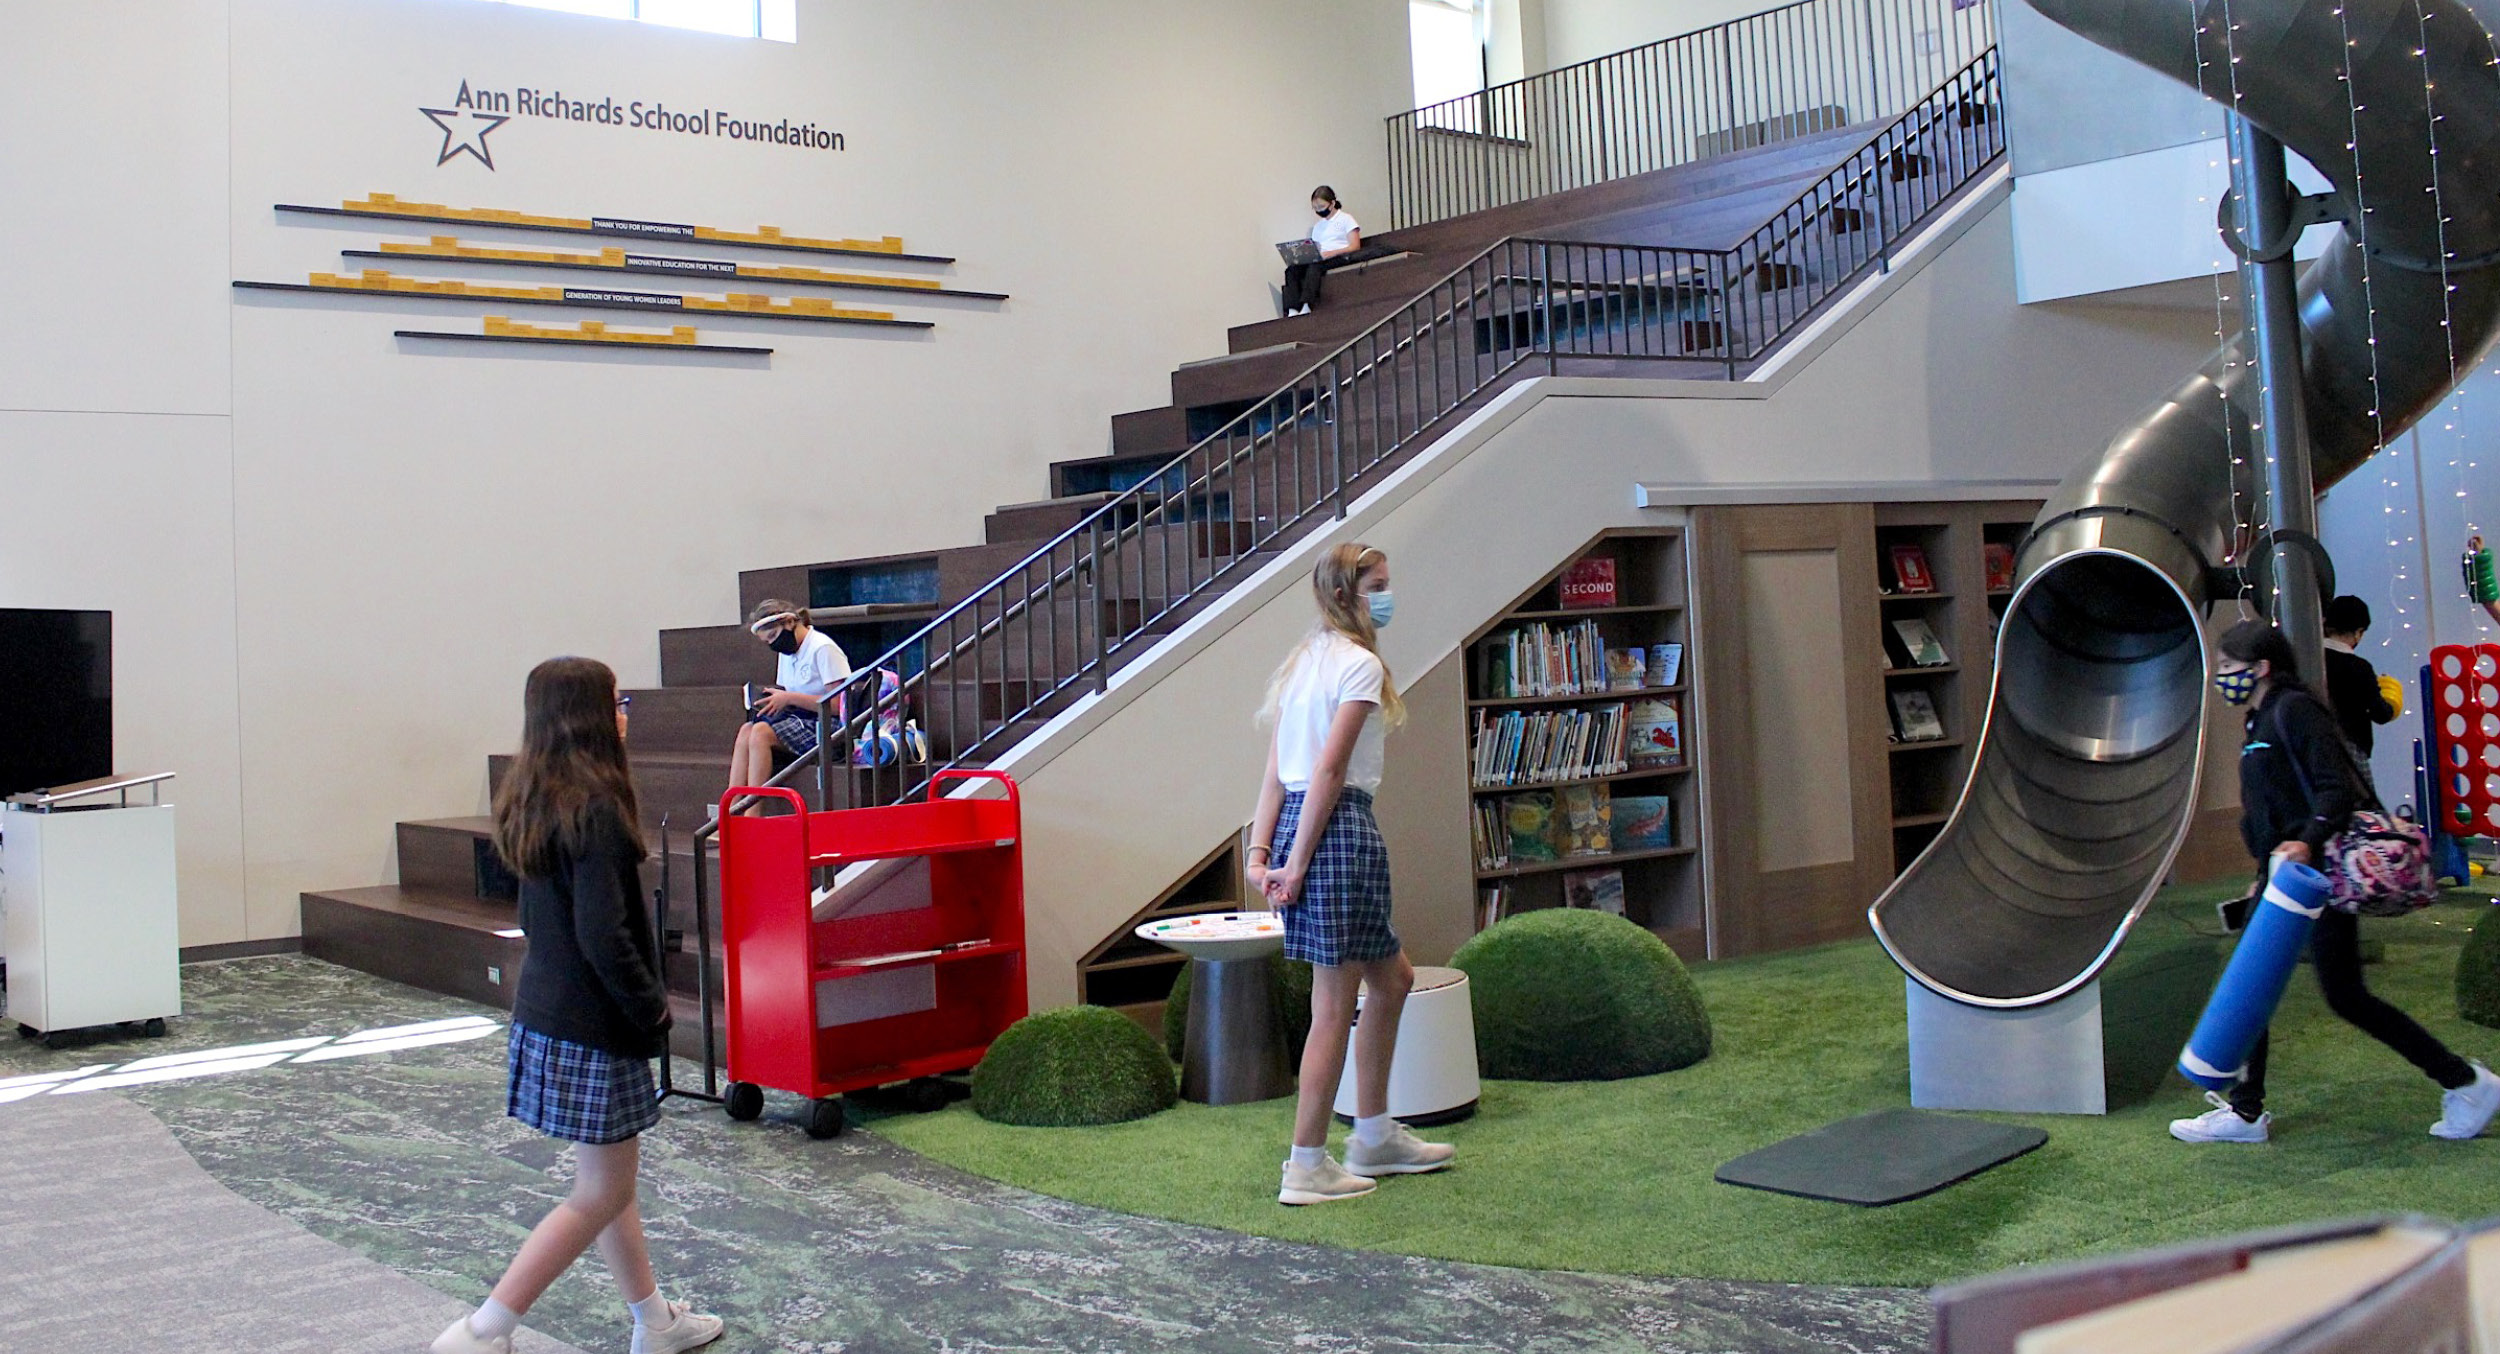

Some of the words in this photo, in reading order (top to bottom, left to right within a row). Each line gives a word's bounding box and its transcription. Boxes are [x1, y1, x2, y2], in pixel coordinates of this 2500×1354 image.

[455, 78, 509, 112] Ann
[518, 88, 624, 126] Richards
[629, 101, 710, 135] School
[716, 112, 845, 151] Foundation
[594, 221, 614, 229] THANK
[615, 222, 628, 230] YOU
[629, 223, 641, 231] FOR
[642, 224, 681, 234] EMPOWERING
[628, 258, 662, 267] INNOVATIVE
[662, 260, 695, 269] EDUCATION
[566, 291, 602, 300] GENERATION
[604, 293, 612, 301] OF
[612, 294, 633, 302] YOUNG
[634, 296, 656, 304] WOMEN
[657, 297, 681, 305] LEADERS
[1564, 582, 1614, 595] SECOND
